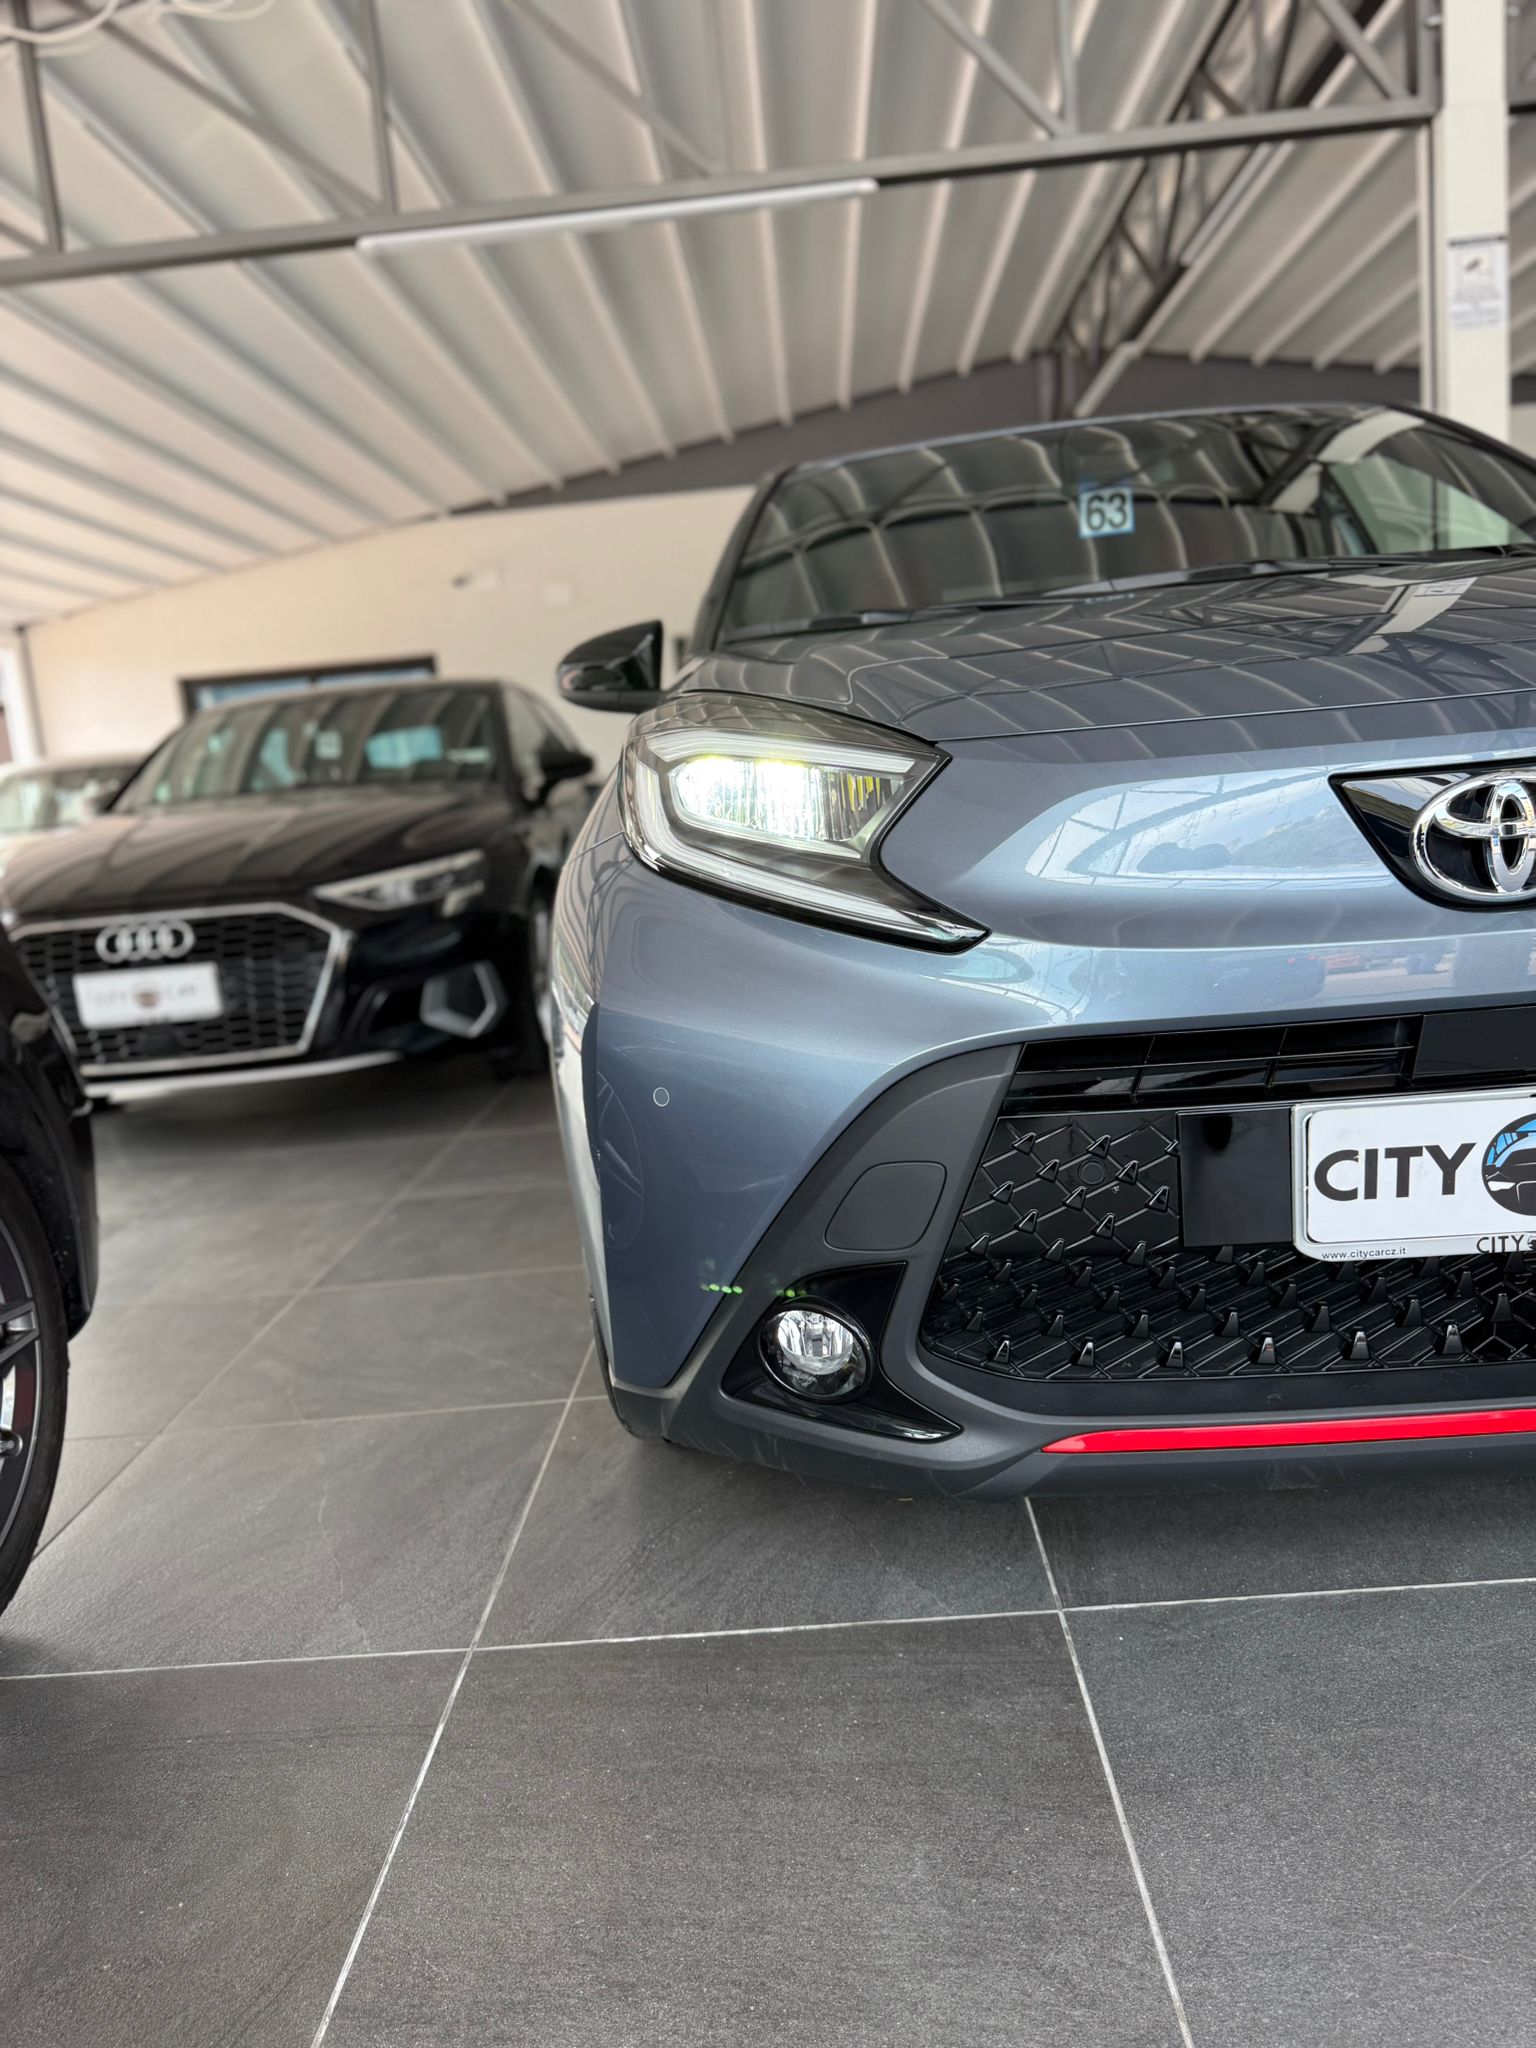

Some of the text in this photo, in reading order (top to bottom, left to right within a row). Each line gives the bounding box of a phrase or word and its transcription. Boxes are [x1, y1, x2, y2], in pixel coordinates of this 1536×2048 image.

[1086, 493, 1127, 531] 63
[1314, 1142, 1477, 1202] CITY
[1321, 1246, 1406, 1259] www.citycarcz.it
[1476, 1234, 1524, 1254] CITY
